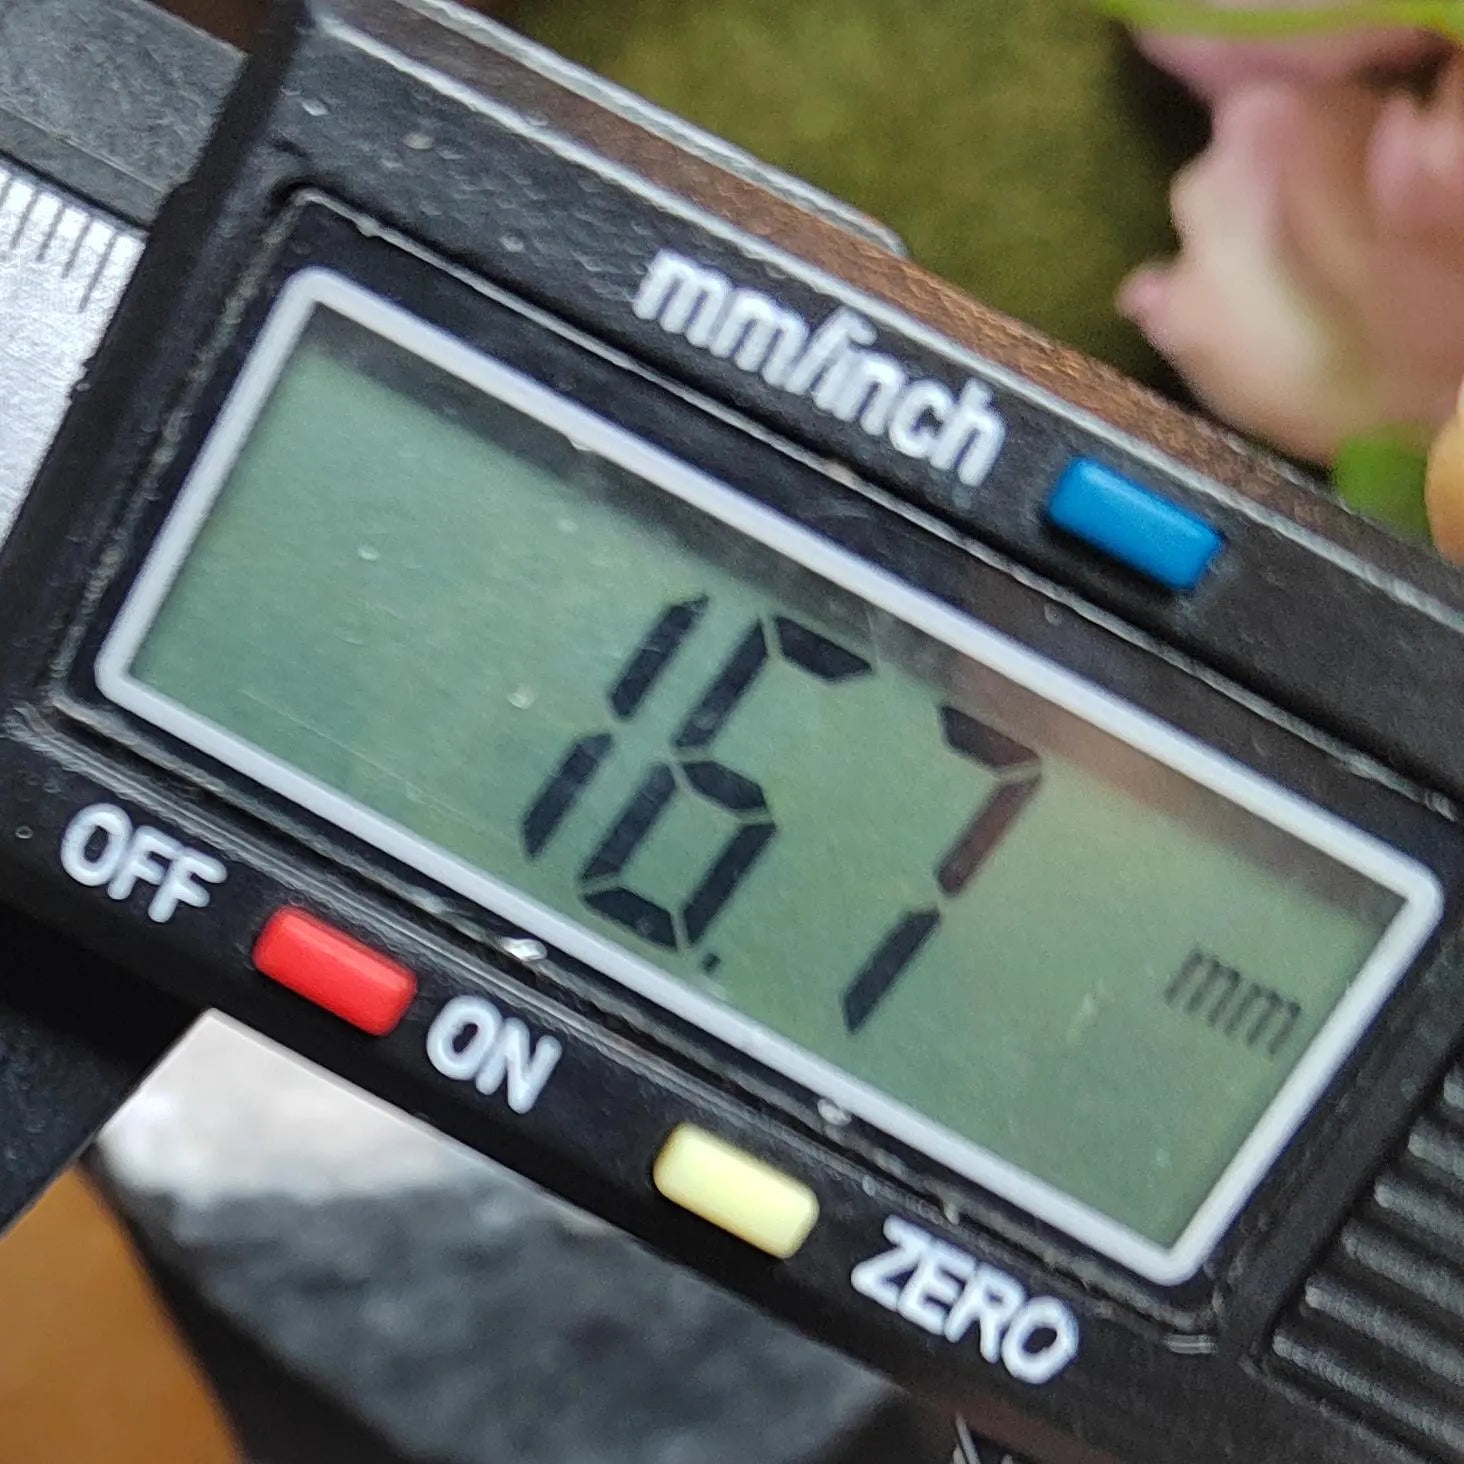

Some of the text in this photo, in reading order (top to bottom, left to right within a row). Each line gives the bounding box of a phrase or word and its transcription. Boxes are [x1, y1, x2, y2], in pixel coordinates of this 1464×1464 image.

[636, 248, 1006, 486] mm/inch
[59, 802, 228, 926] OFF
[522, 595, 1305, 1060] 16.7 mm
[423, 996, 564, 1113] ON
[849, 1215, 1083, 1385] ZERO
